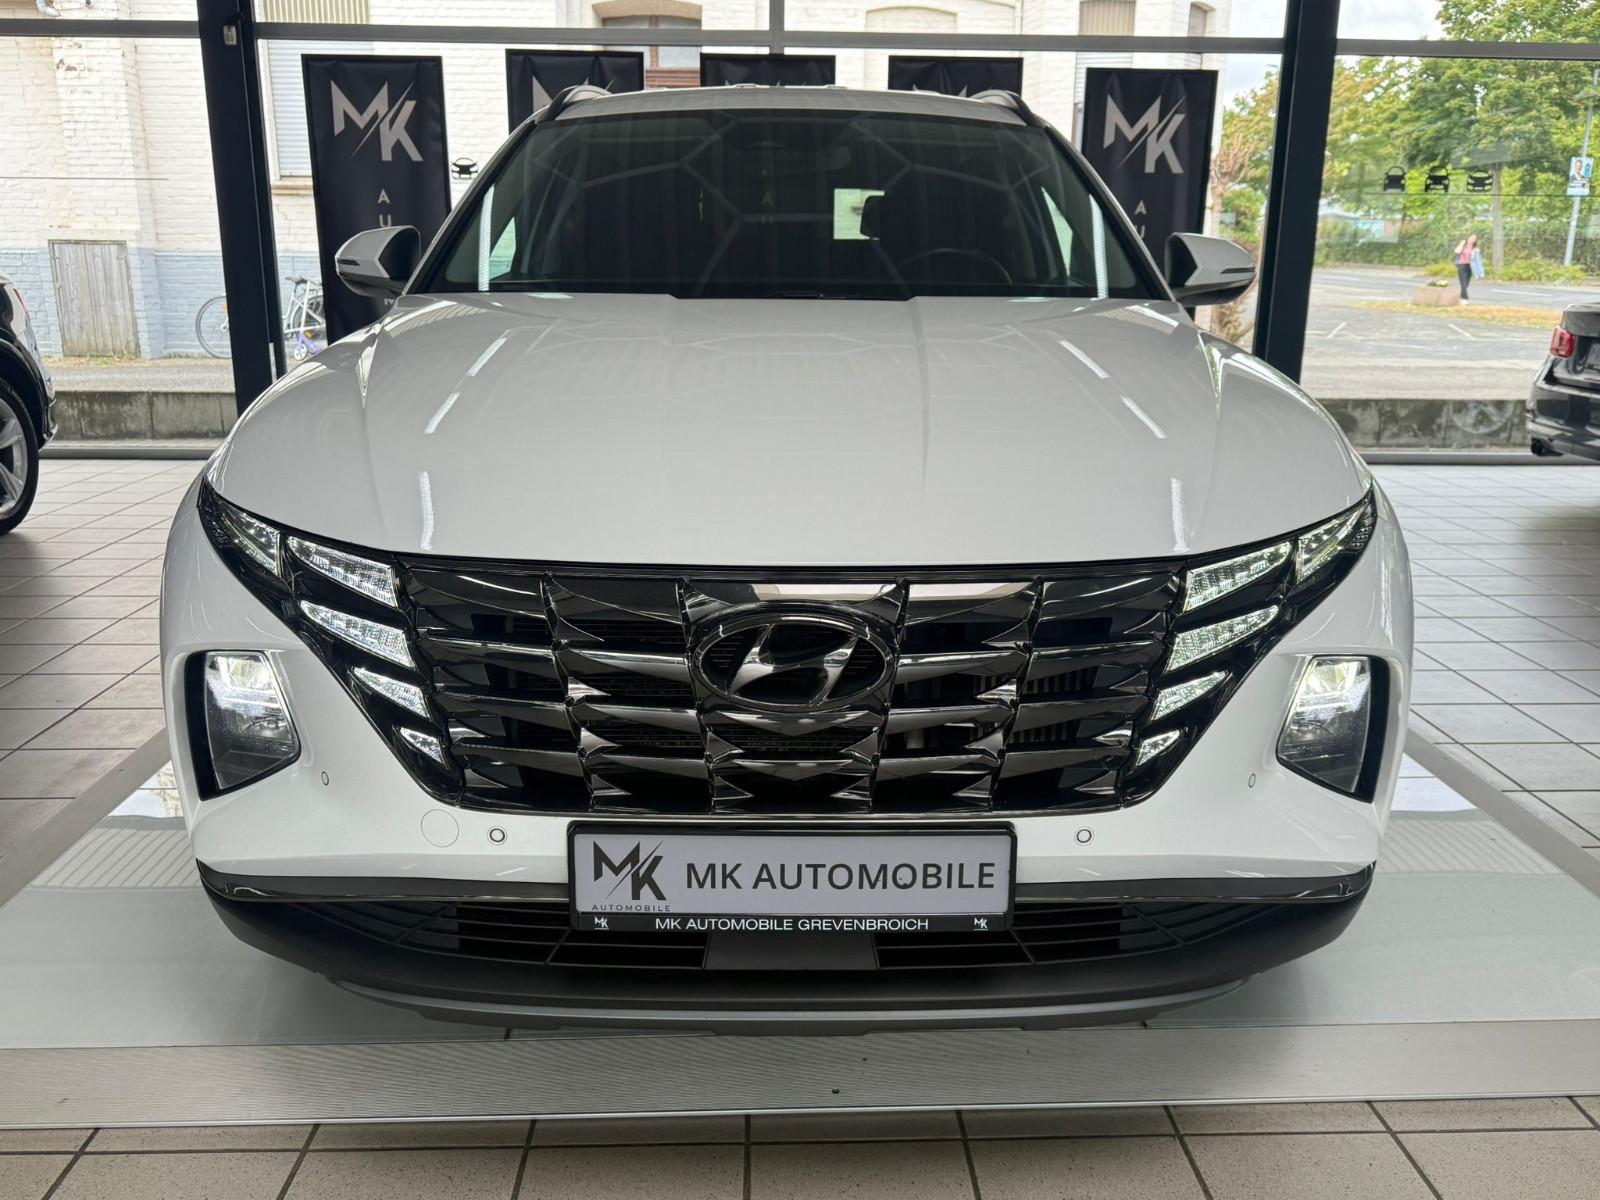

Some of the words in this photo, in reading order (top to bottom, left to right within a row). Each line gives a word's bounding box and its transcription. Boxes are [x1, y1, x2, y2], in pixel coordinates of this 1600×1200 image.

[330, 79, 424, 162] MK
[1103, 94, 1187, 174] MK
[593, 840, 667, 901] MK
[686, 862, 742, 889] MK
[751, 862, 995, 890] AUTOMOBILE
[592, 904, 671, 912] AUTOMOBILE
[655, 918, 682, 930] MK
[685, 918, 793, 931] AUTOMOBILE
[798, 918, 929, 931] GREVENBROICH
